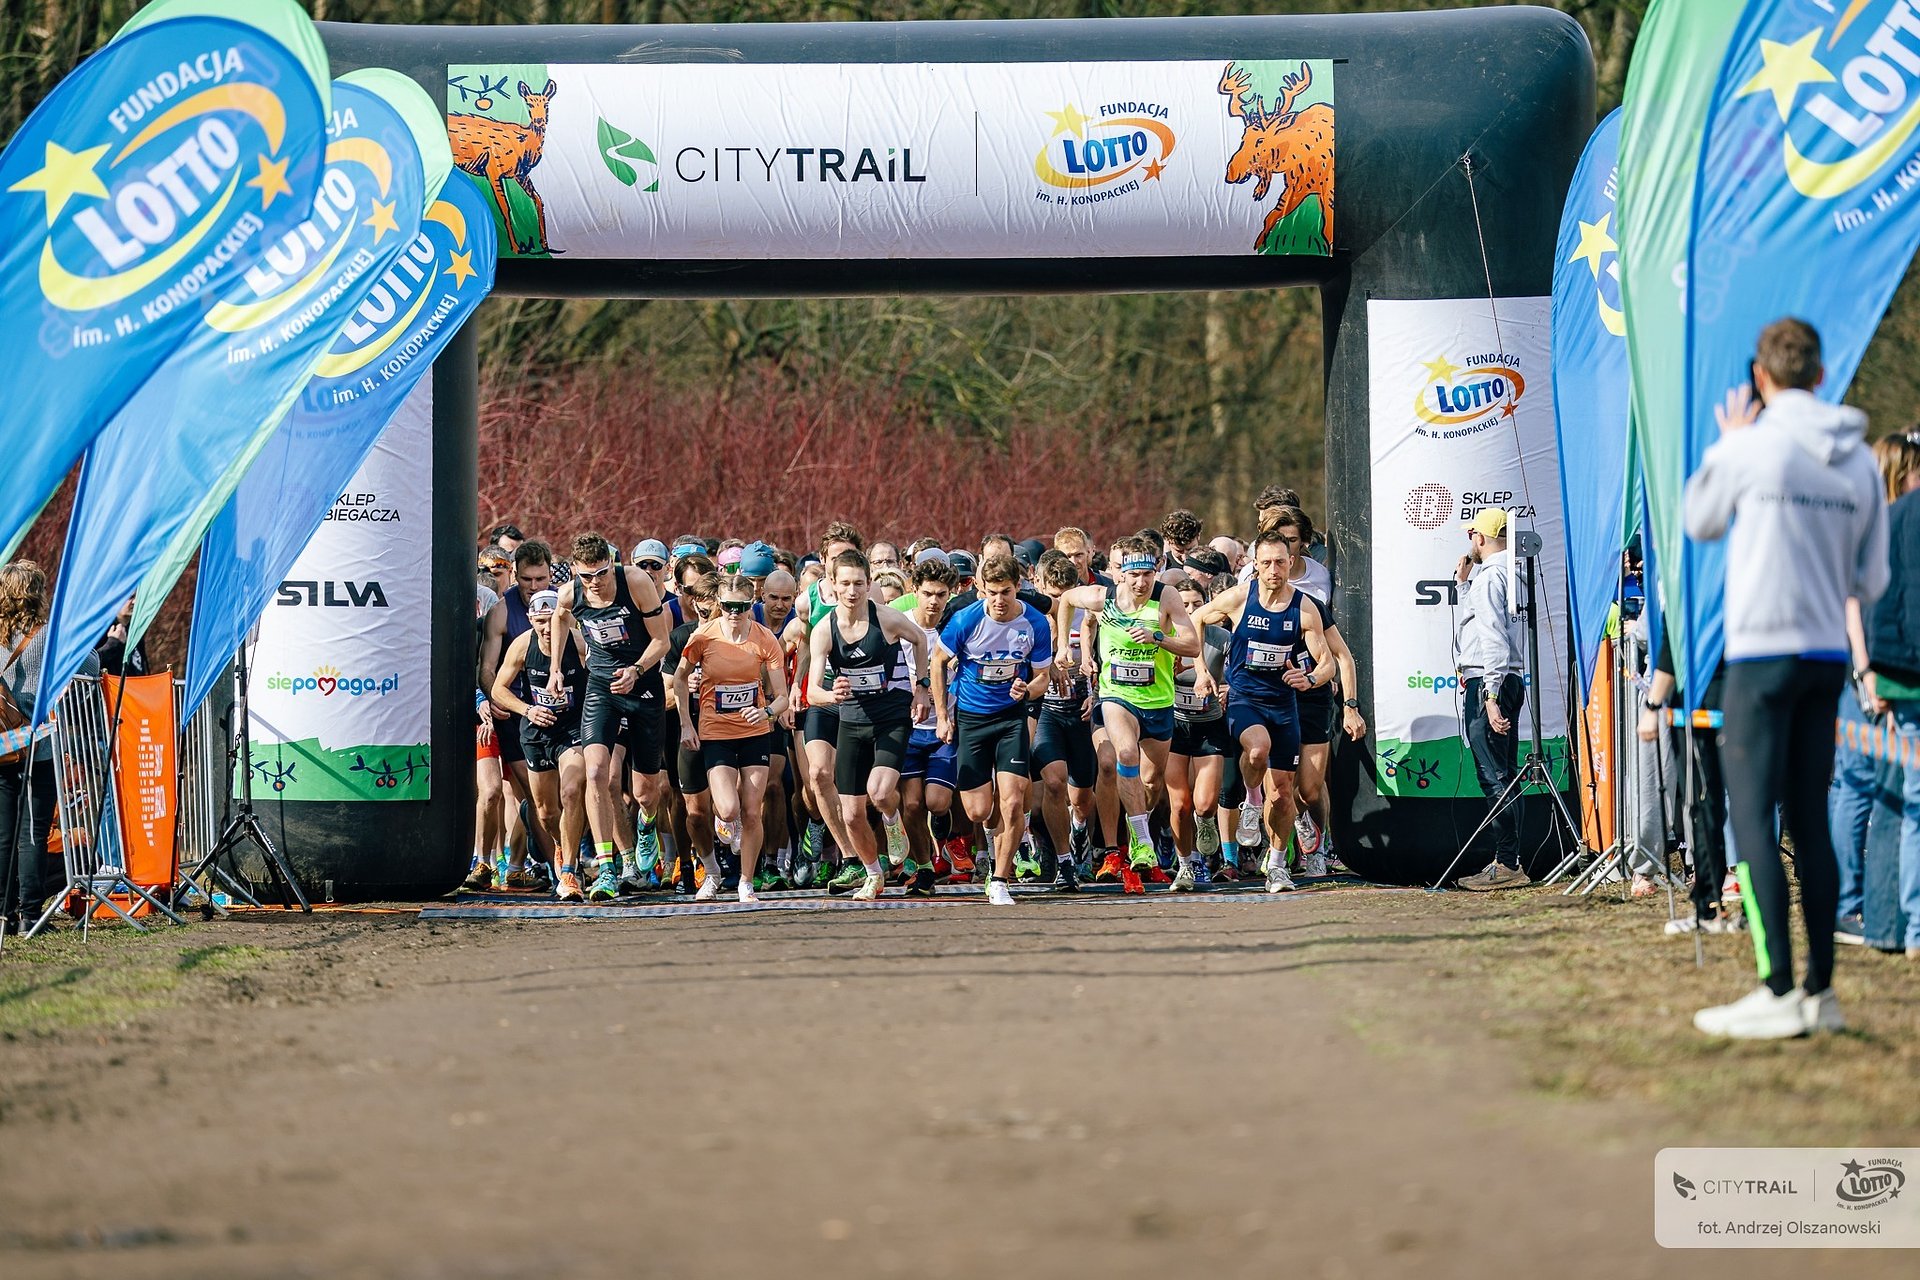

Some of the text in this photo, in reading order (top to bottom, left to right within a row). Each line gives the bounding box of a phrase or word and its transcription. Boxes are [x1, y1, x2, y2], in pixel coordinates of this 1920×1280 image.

[107, 47, 245, 134] FUNDACJA
[1100, 101, 1169, 119] FUNDACJA
[1062, 131, 1148, 174] LOTTO
[72, 118, 240, 270] LOTTO
[1035, 179, 1140, 206] im. H. KONOPACKIEJ
[1871, 187, 1900, 212] H.
[73, 210, 265, 349] im. H. KONOPACKIEJ
[227, 247, 376, 364] im. H. KONOPACKIEJ
[332, 389, 360, 405] im.
[361, 377, 381, 394] H.
[379, 293, 460, 382] KONOPACKIEJ
[1466, 353, 1521, 368] FUNDACJA
[1435, 377, 1505, 413] LOTTO
[1415, 416, 1499, 439] im. H. KONOPACKIEJ
[335, 493, 376, 506] KLEP
[1461, 491, 1513, 505] SKLEP
[323, 508, 401, 522] BIEGACZA
[277, 580, 390, 608] SILVA
[1247, 614, 1270, 627] ZRC
[600, 629, 609, 639] 5
[1262, 652, 1276, 662] 18
[995, 667, 1004, 676] 4
[1124, 668, 1139, 677] 10
[859, 676, 868, 686] 3
[726, 692, 750, 703] 747
[1182, 694, 1192, 705] 11
